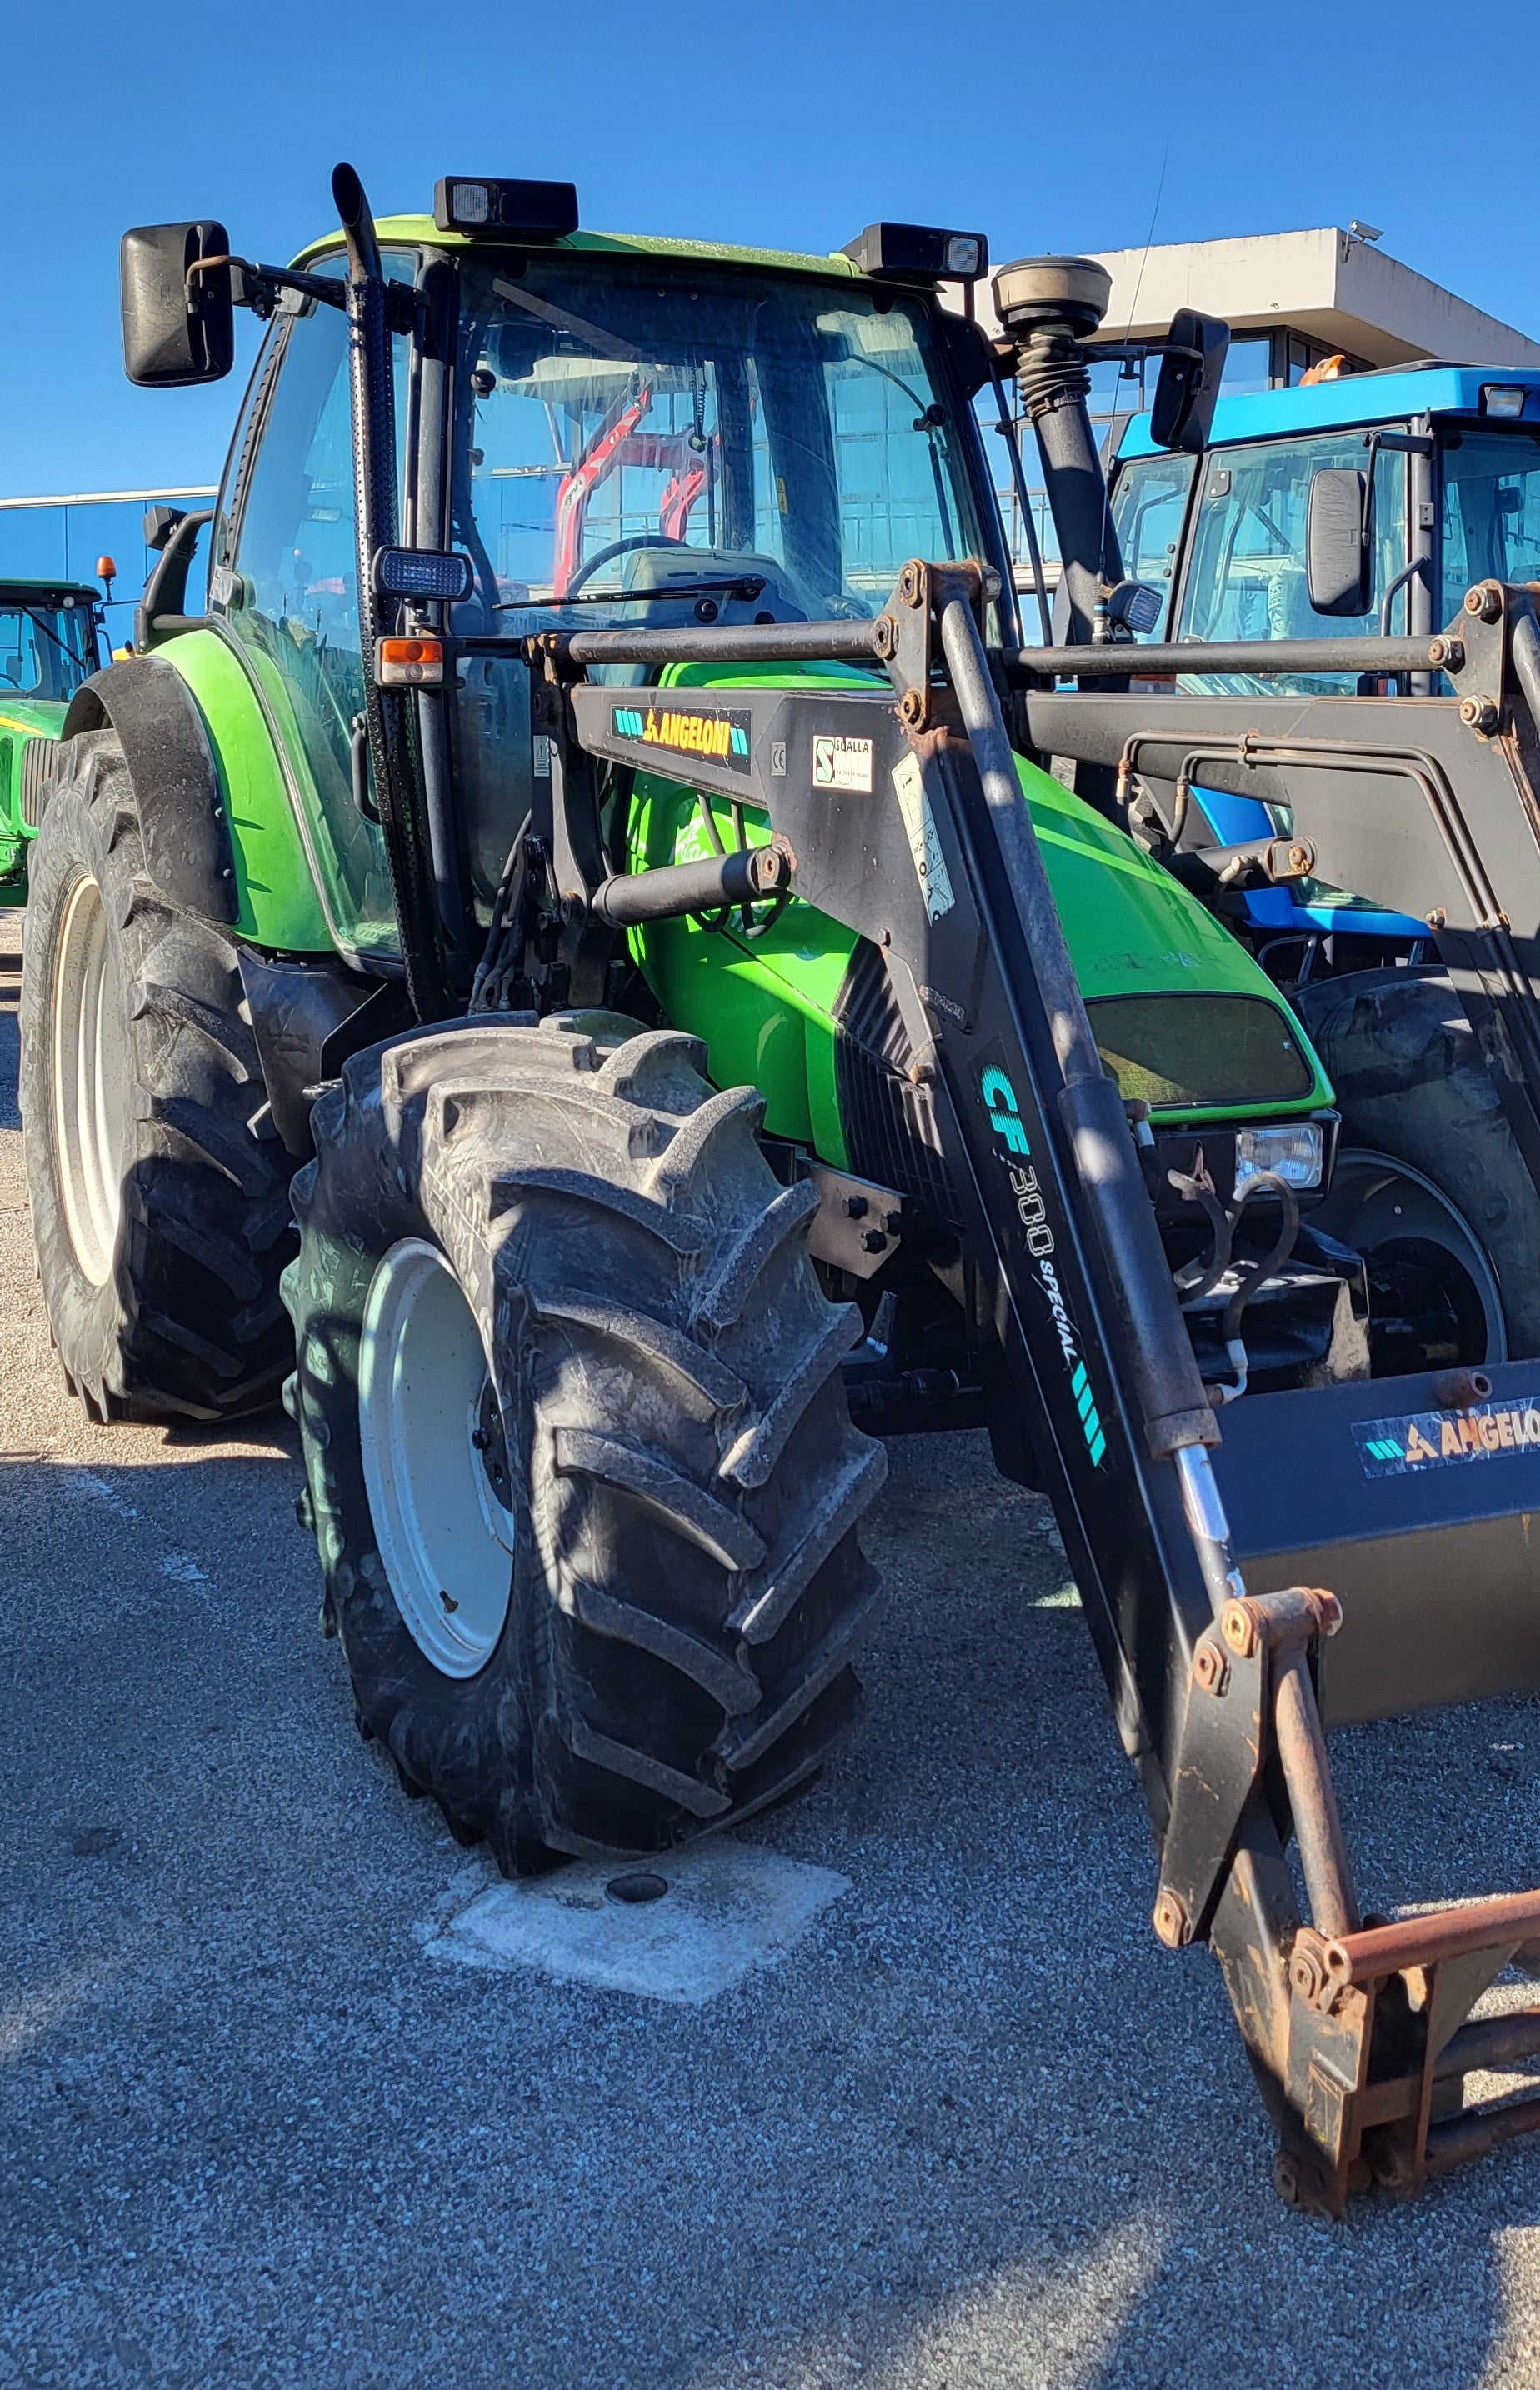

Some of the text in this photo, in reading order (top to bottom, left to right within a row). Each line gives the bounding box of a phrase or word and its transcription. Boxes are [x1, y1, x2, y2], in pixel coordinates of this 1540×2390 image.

[658, 712, 731, 756] ANGELONI
[772, 749, 784, 769] CE
[982, 1063, 1078, 1371] CF 300 SPECIAL
